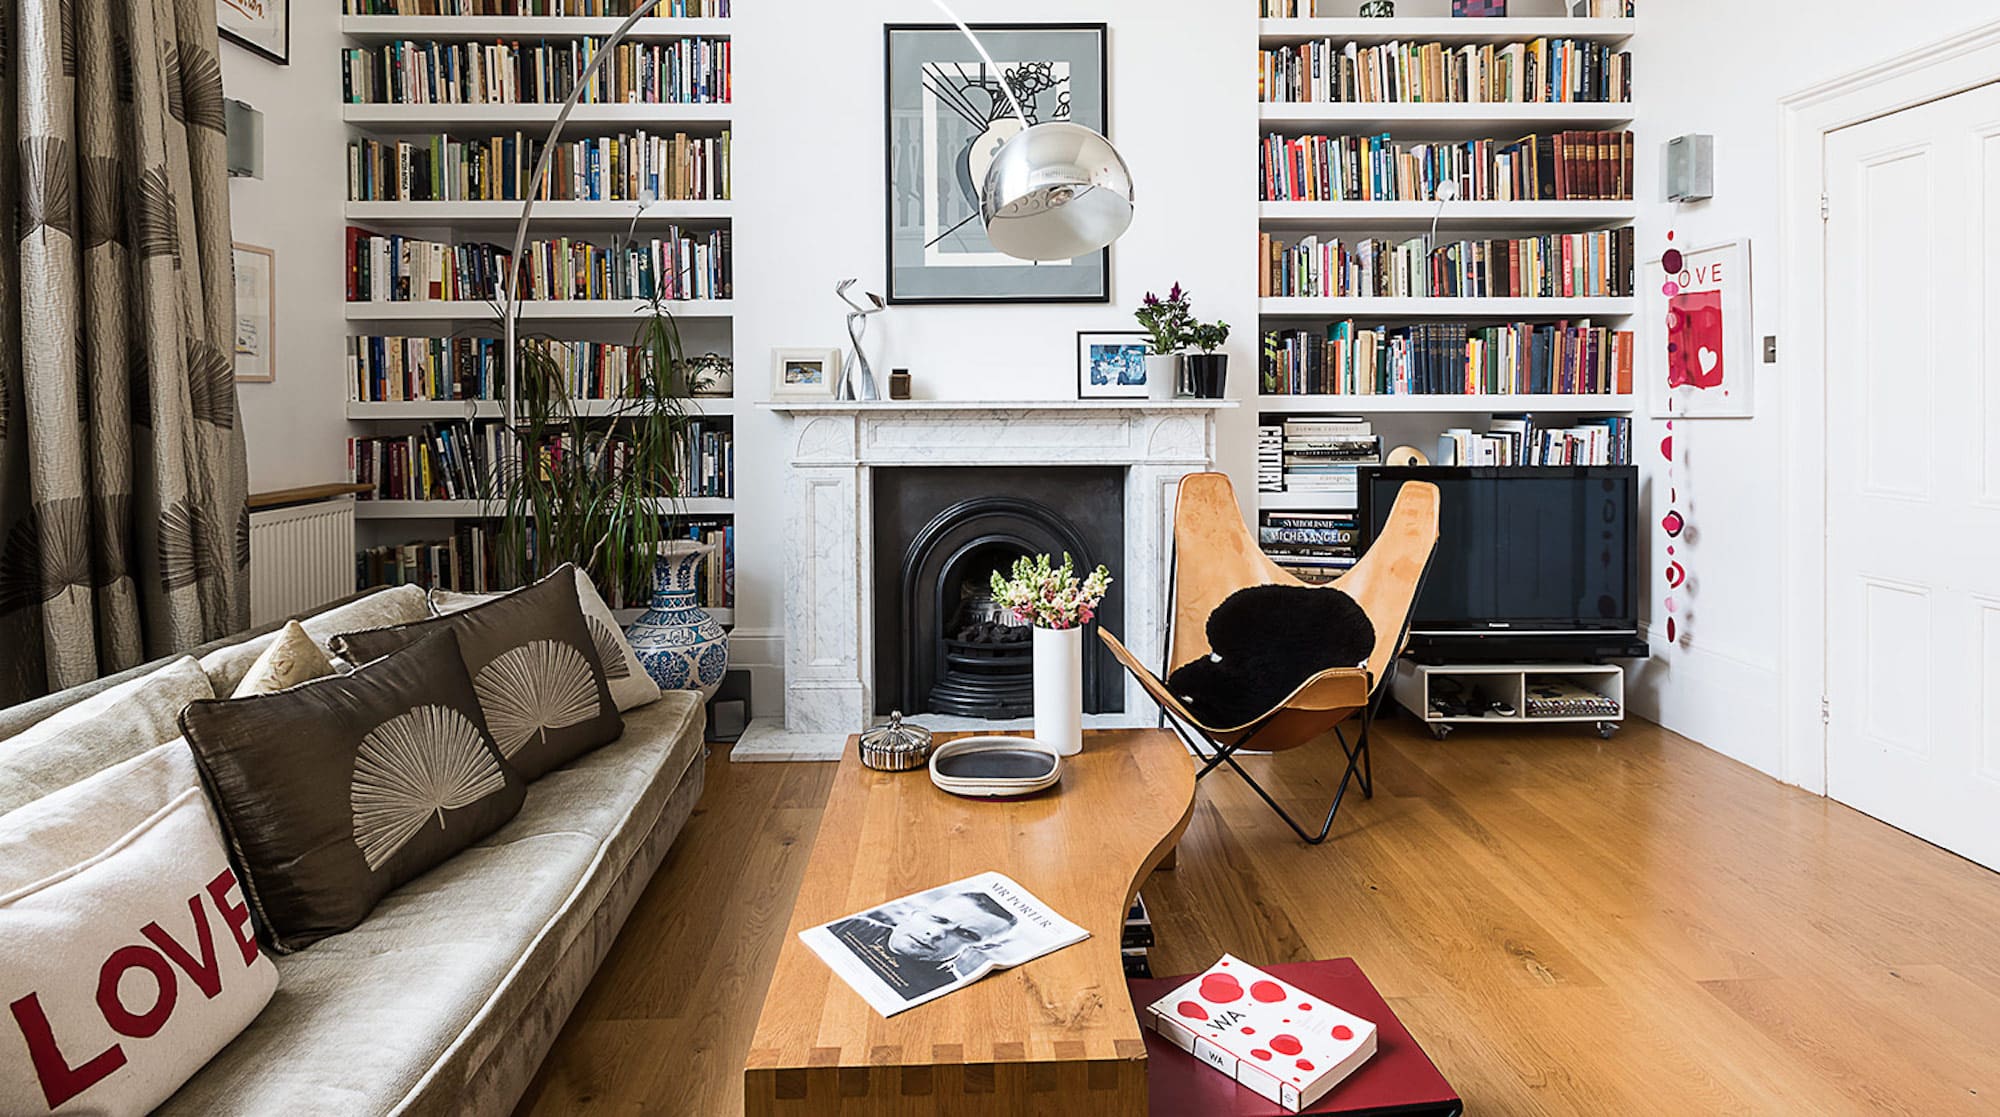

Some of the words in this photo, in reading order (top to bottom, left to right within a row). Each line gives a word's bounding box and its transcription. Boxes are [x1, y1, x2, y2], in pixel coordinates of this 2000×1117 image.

[1665, 264, 1722, 288] OVE
[1259, 426, 1282, 492] CENTURY
[1283, 519, 1334, 528] SYMBOLISME
[1270, 530, 1351, 543] MICHELANGELO
[992, 882, 1010, 898] MR
[1006, 895, 1052, 928] PORTER
[10, 867, 259, 1110] LOVE
[1206, 1010, 1247, 1031] WA
[1208, 1050, 1224, 1067] WA
